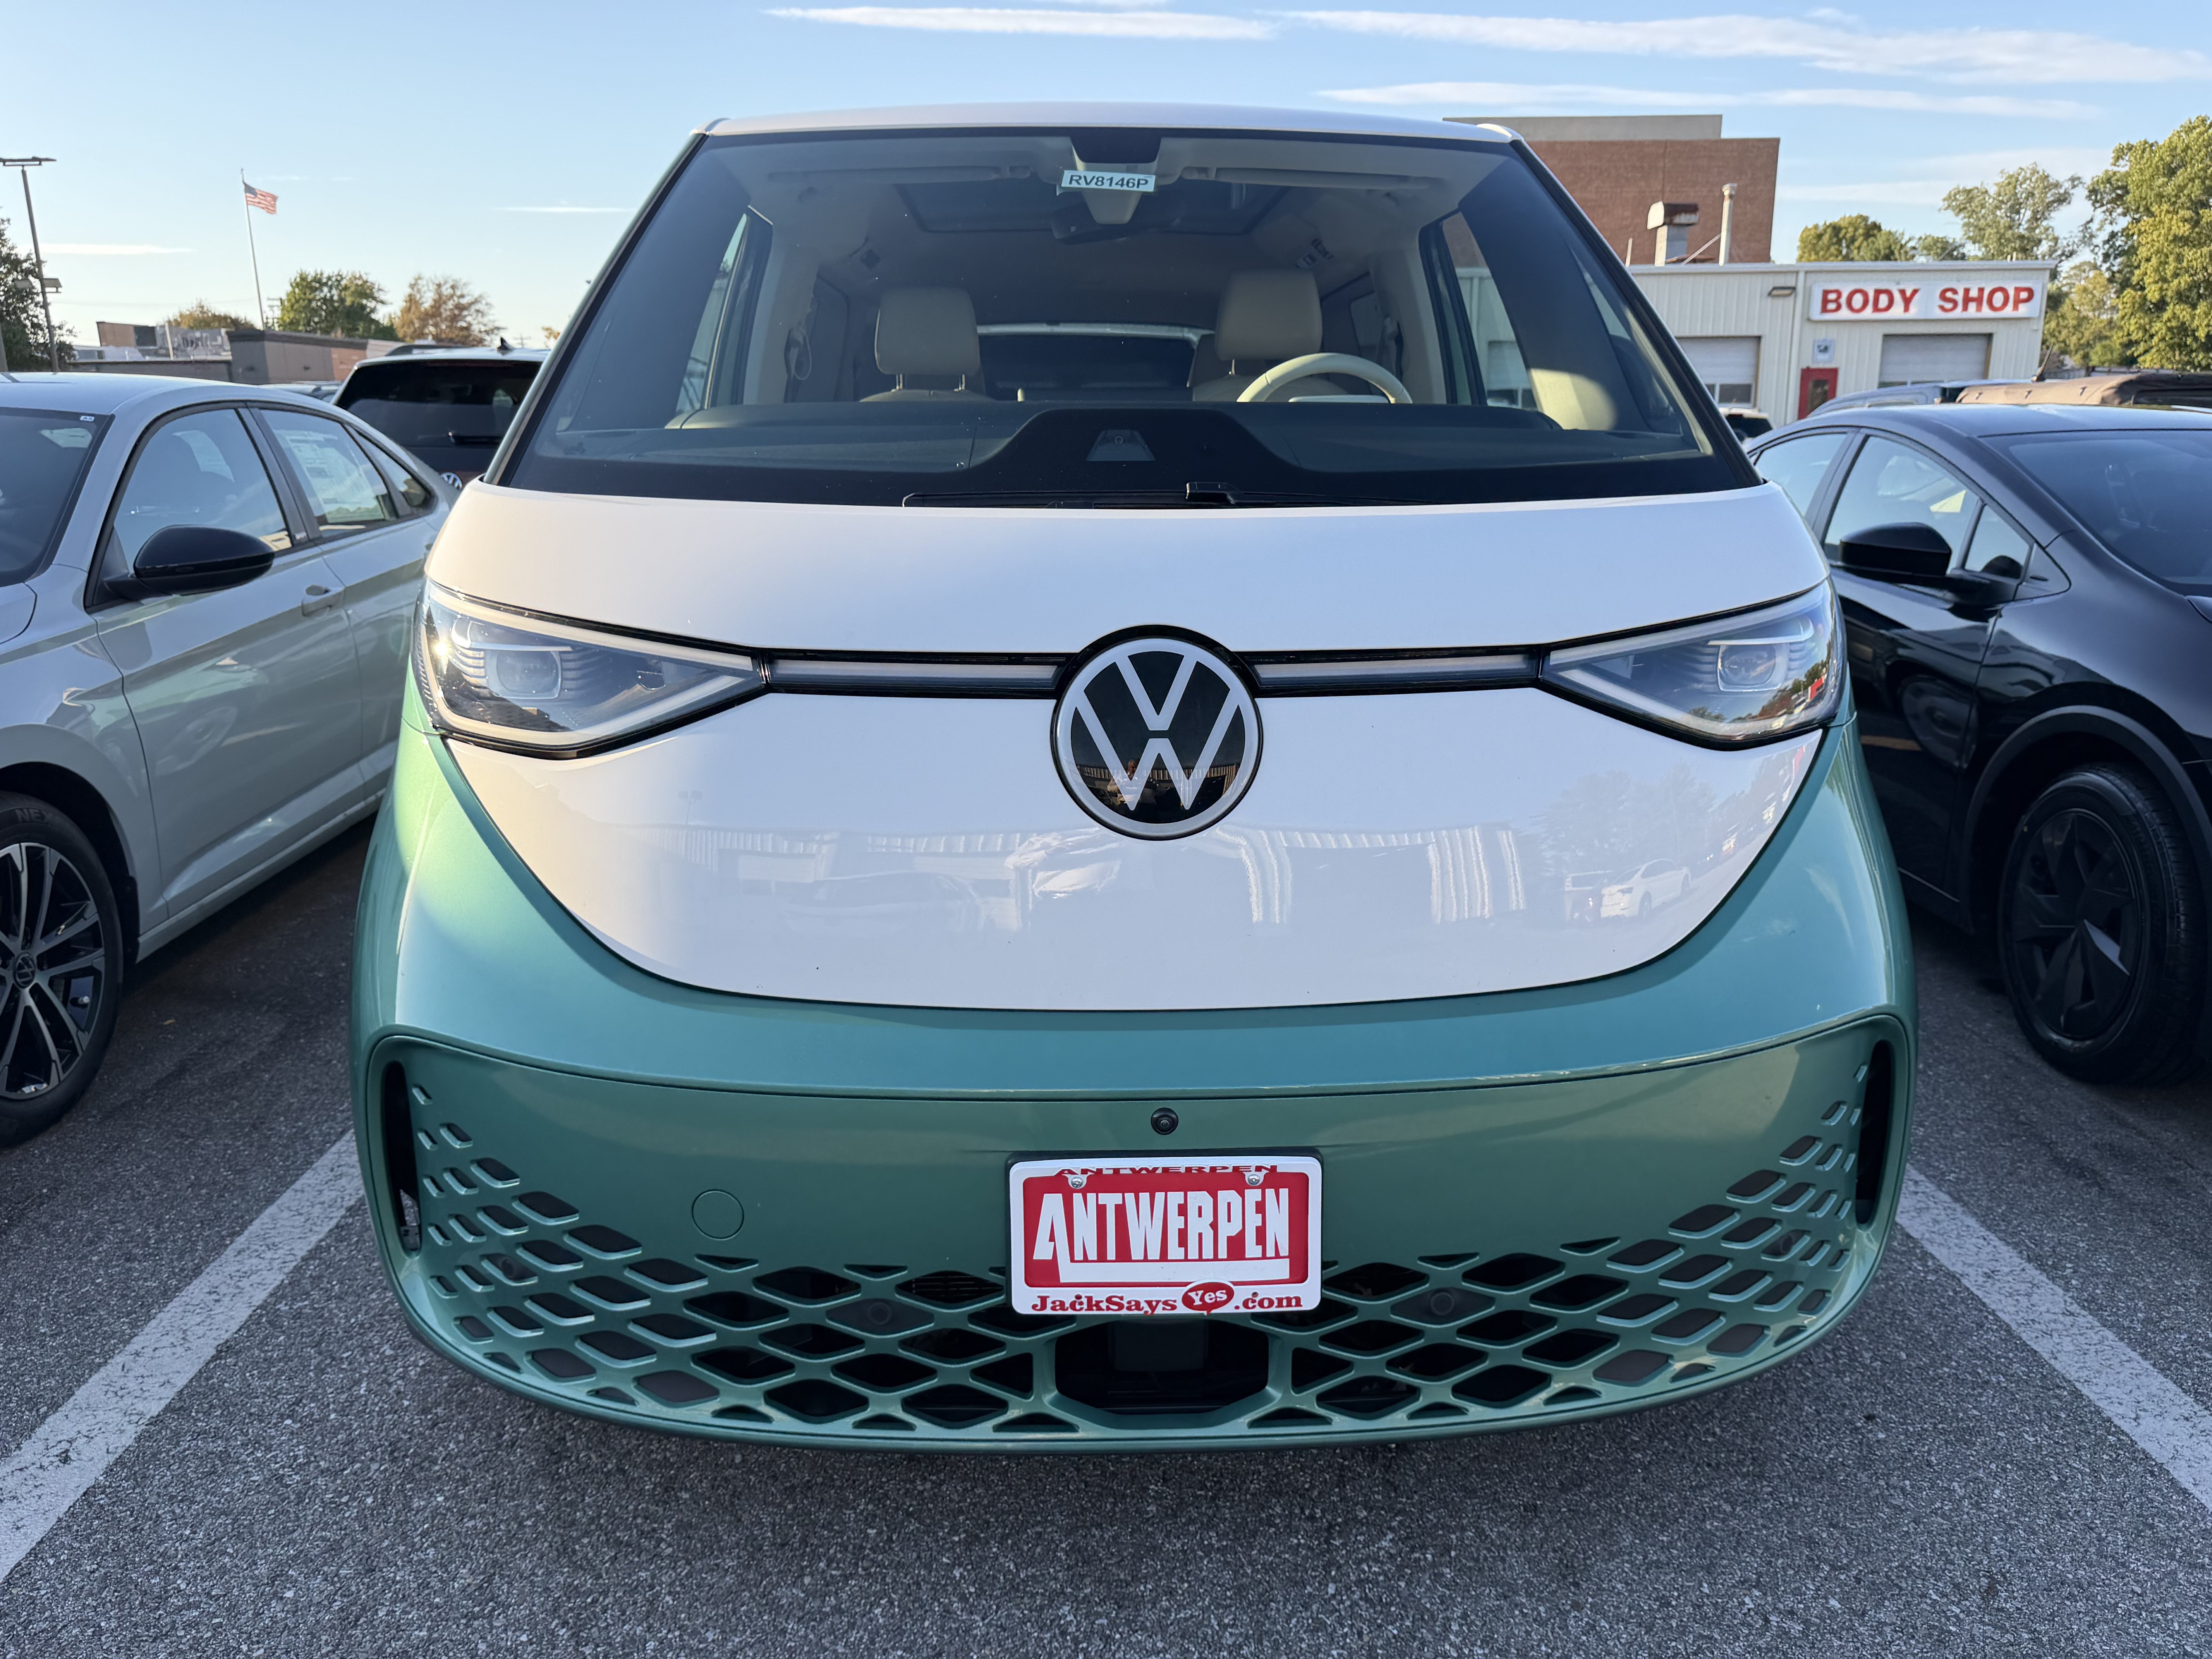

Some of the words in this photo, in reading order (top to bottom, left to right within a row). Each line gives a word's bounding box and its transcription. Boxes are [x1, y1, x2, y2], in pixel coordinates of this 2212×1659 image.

[1069, 175, 1148, 189] RV8146P
[1820, 288, 1920, 314] BODY
[1938, 286, 2034, 313] SHOP
[1071, 651, 1244, 812] VW
[1053, 1164, 1278, 1176] ANTWERPEN
[1033, 1188, 1289, 1261] ANTWERPEN
[1188, 1288, 1227, 1305] Yes
